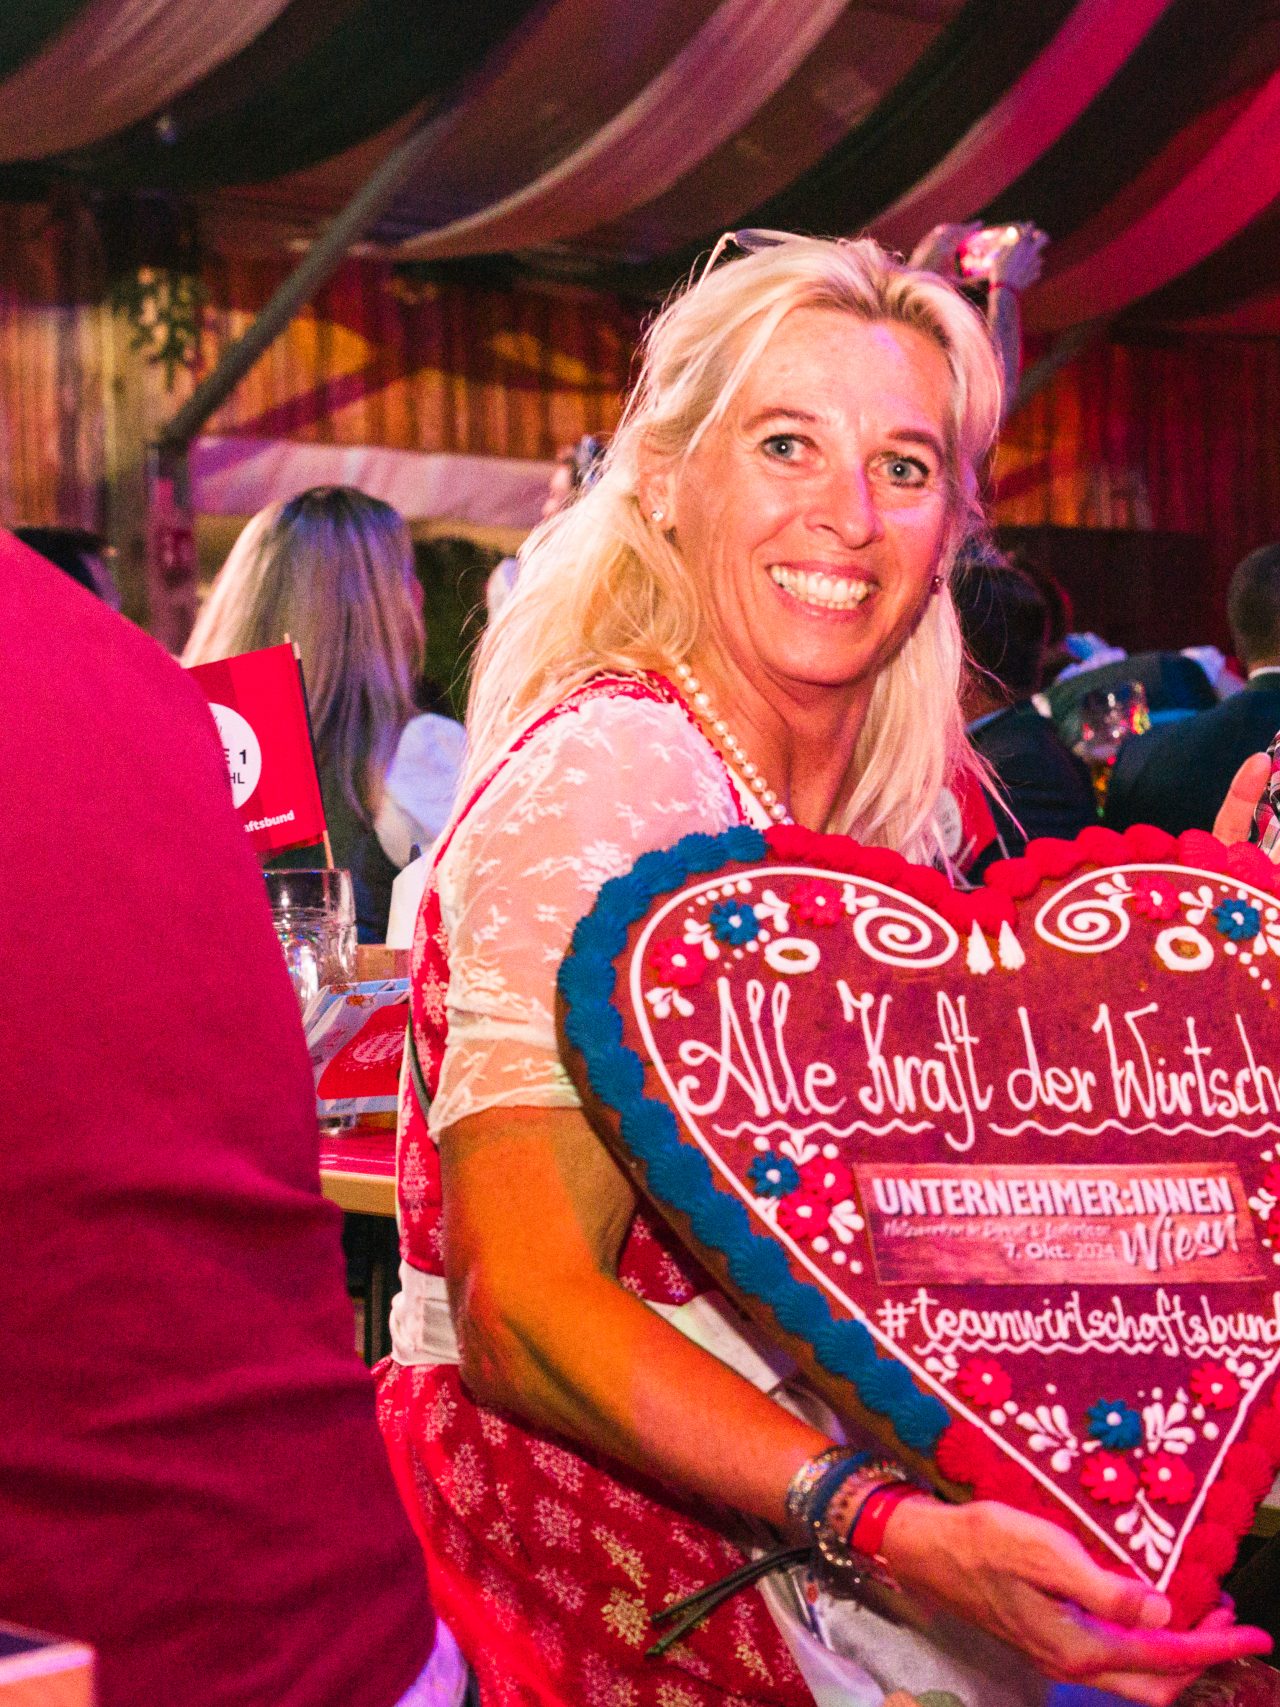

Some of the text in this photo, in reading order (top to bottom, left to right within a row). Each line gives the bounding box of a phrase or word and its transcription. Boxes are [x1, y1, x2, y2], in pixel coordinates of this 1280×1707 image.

[238, 749, 247, 765] 1
[677, 976, 848, 1117] Alle
[836, 978, 995, 1152] Kraft
[1006, 1006, 1097, 1112] der
[872, 1177, 1236, 1216] UNTERNEHMER:INNEN
[1119, 1211, 1240, 1272] Wiesn
